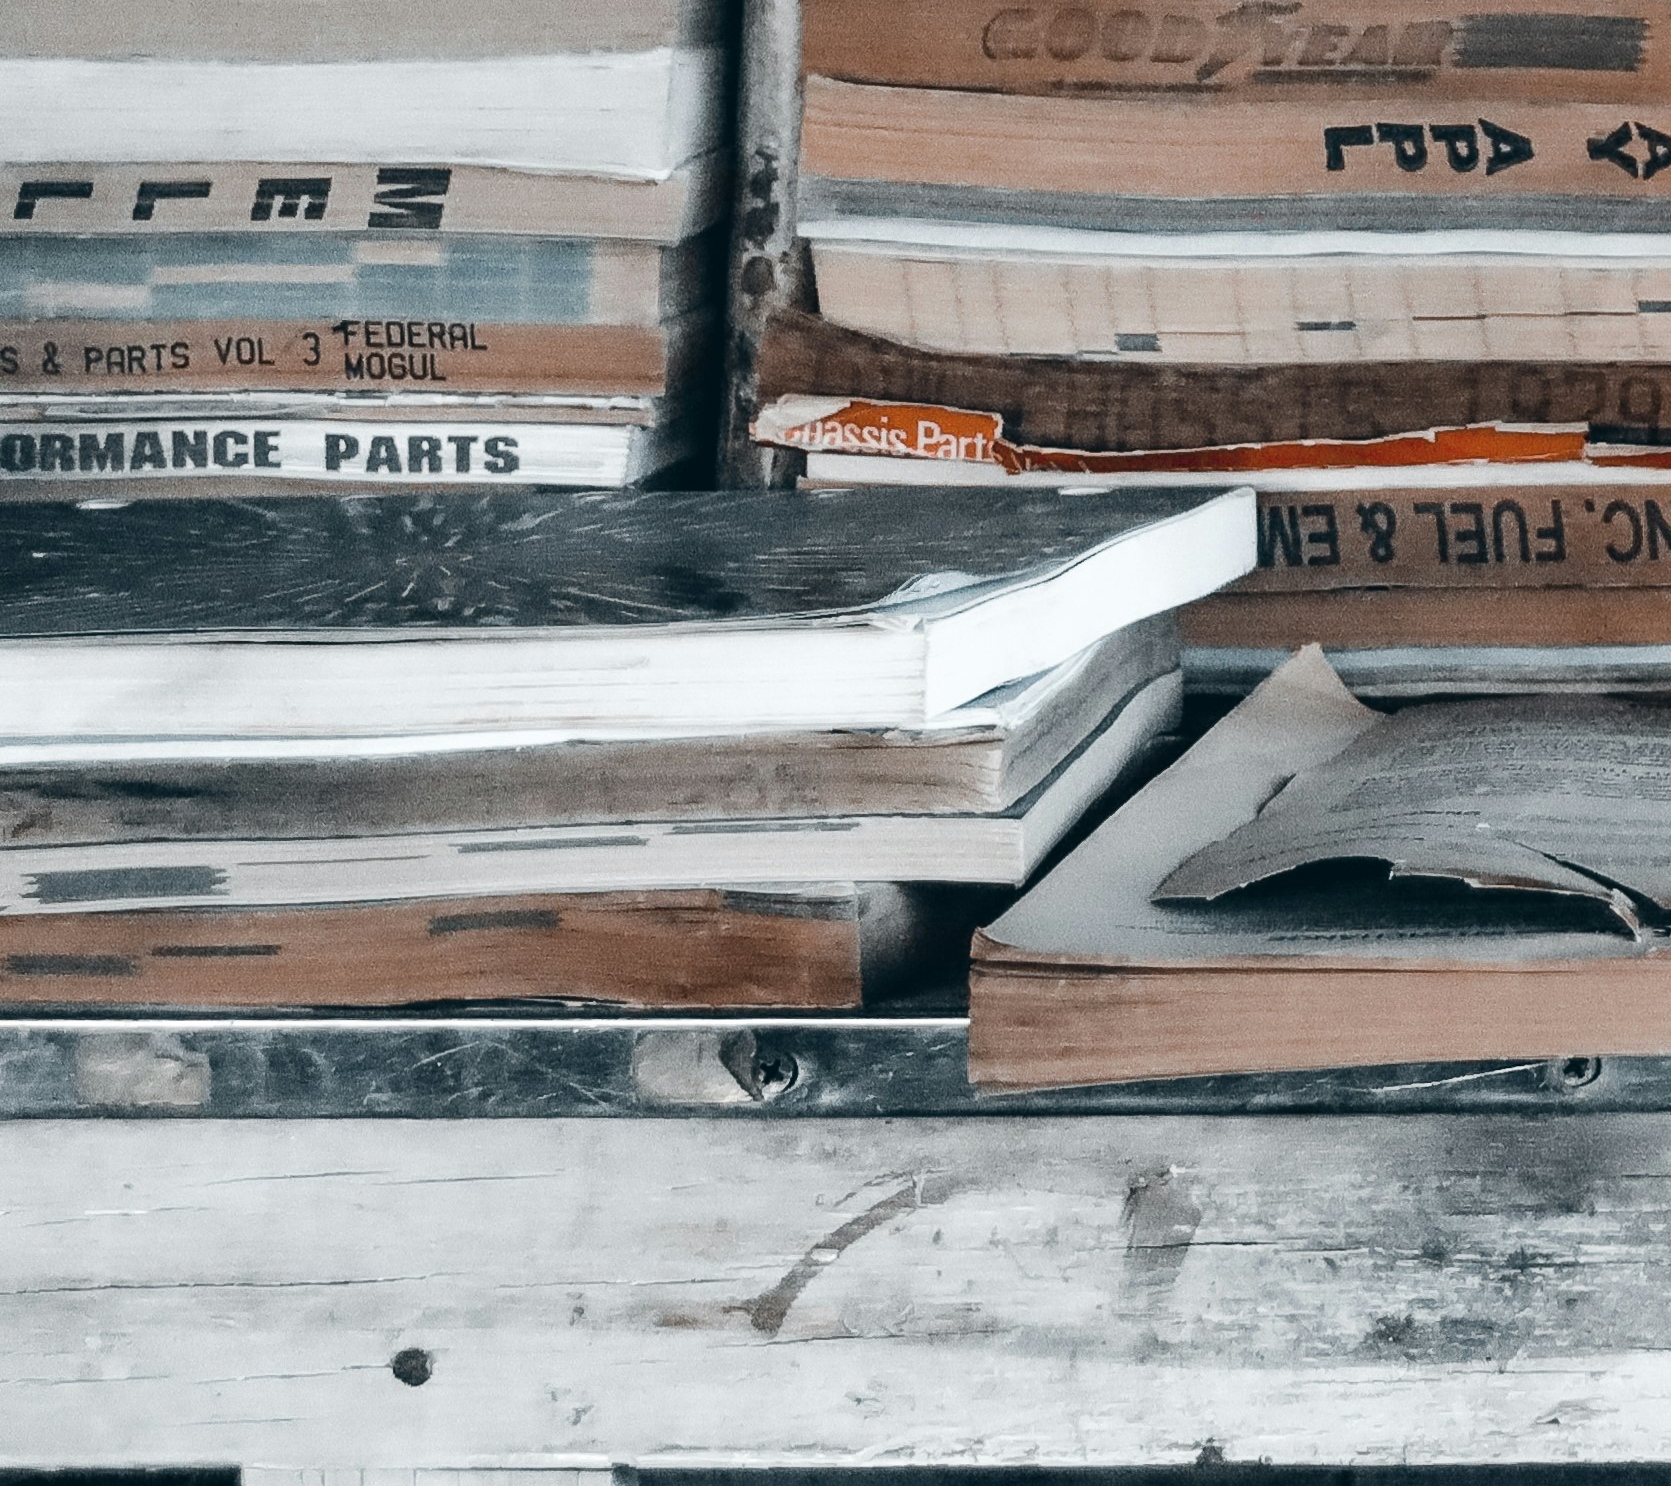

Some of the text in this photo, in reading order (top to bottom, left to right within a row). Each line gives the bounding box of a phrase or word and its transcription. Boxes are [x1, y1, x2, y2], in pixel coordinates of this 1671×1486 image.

[1323, 118, 1536, 177] APPL
[40, 331, 321, 378] & PARTS VOL 3
[343, 319, 488, 353] FEDERAL
[344, 351, 447, 383] MOGUL
[323, 432, 521, 475] PARTS
